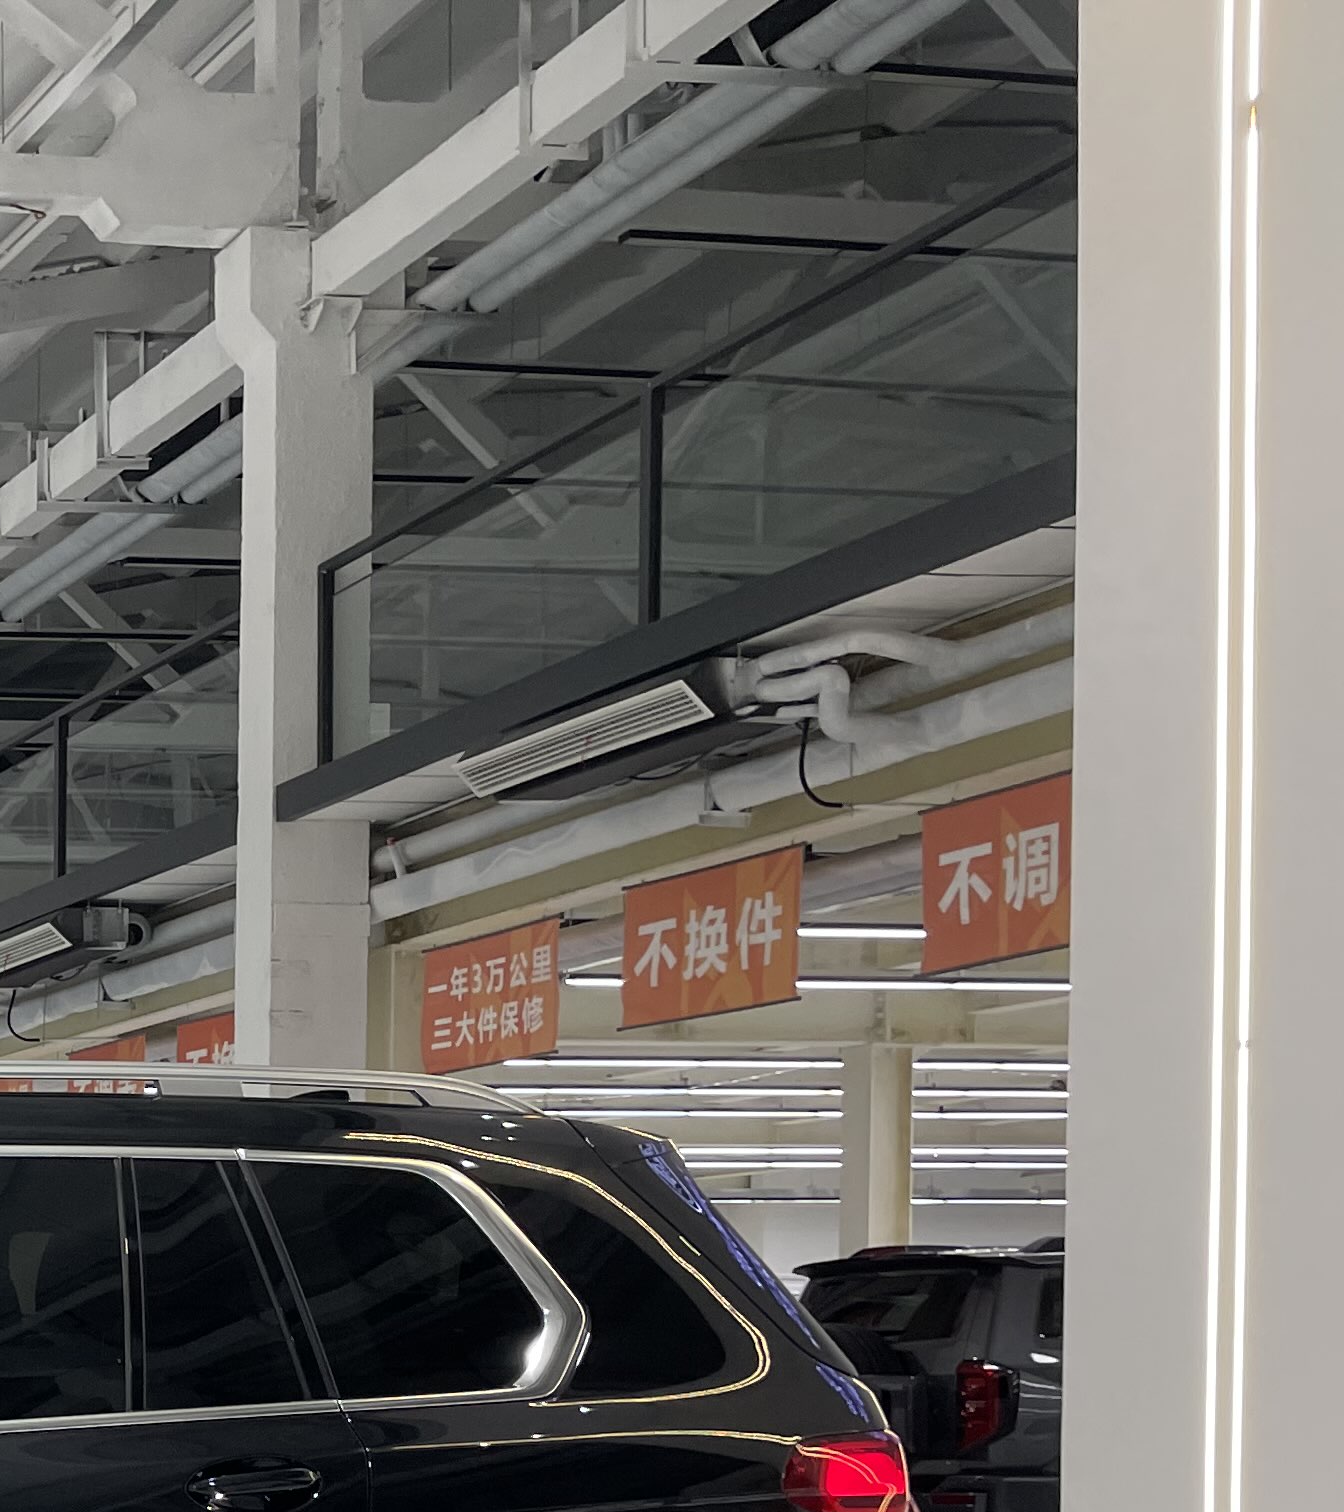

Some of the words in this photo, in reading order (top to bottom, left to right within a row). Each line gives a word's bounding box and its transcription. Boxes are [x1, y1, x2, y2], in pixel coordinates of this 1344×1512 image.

[938, 822, 1060, 925] 不调
[428, 944, 552, 1001] 一年3万公里
[634, 891, 782, 987] 不换件
[431, 995, 544, 1050] 三大件保修
